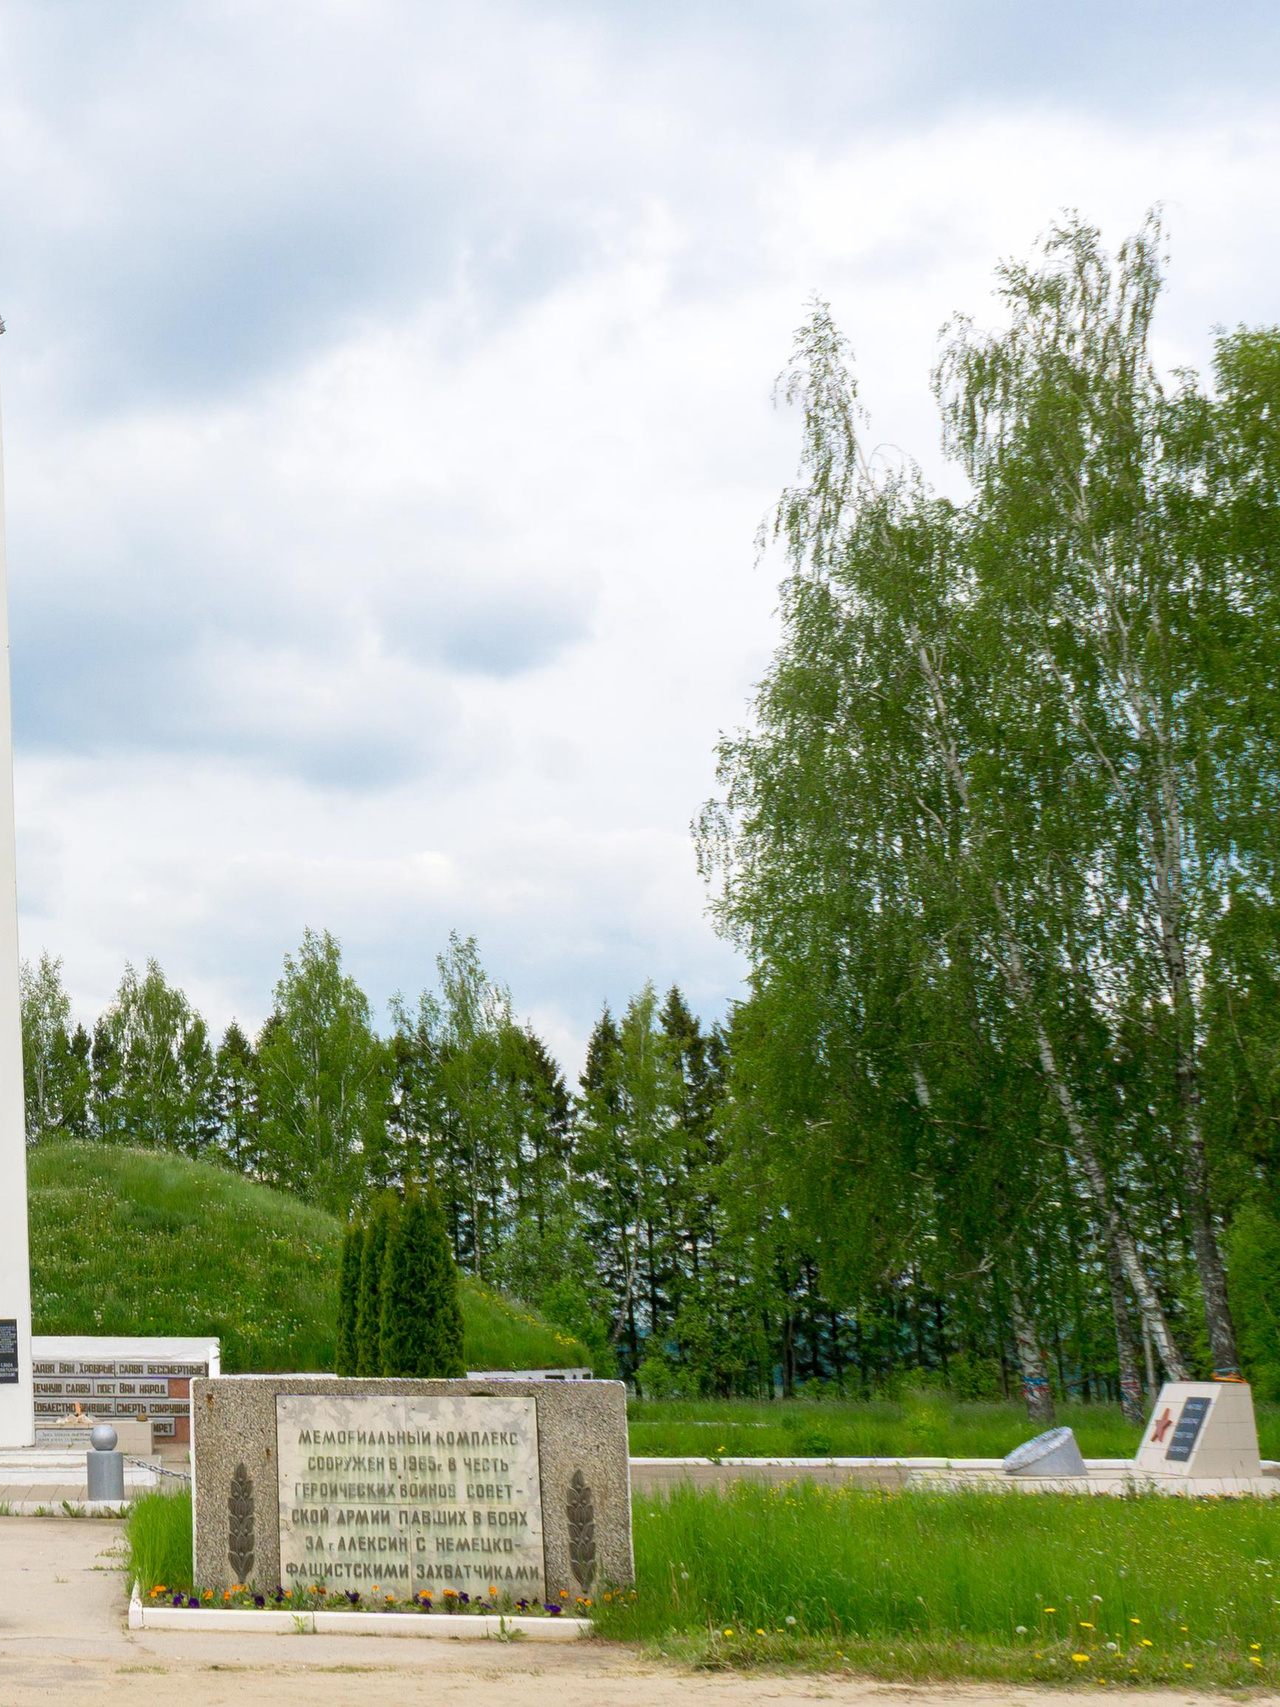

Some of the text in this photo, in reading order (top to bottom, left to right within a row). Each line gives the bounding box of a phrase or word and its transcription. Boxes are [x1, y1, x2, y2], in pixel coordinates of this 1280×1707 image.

[119, 1364, 143, 1374] СЛАВА
[66, 1382, 91, 1394] СЛАВУ
[97, 1383, 116, 1394] ПОЕТ
[119, 1382, 135, 1394] ВАМ
[140, 1384, 166, 1394] НАРОД
[117, 1403, 146, 1413] СМЕРТЬ
[436, 1430, 518, 1446] КОМПЛЕКС
[308, 1456, 385, 1472] СООРУЖЕН
[389, 1457, 398, 1472] В
[448, 1457, 457, 1472] В
[463, 1457, 509, 1472] ЧЕСТЬ
[295, 1482, 396, 1498] ГЕРОИЧЕСКИХ
[400, 1483, 456, 1499] ВОИНОВ
[291, 1507, 528, 1526] СКОЙ АРМИИ ПАВШИХ В БОЯХ
[305, 1535, 325, 1551] ЗА
[338, 1536, 408, 1551] АЛЕКСИН
[416, 1536, 426, 1552] С
[436, 1537, 521, 1554] НЕМЕЦКО-
[286, 1561, 409, 1579] ФАШИСТСКИМИ
